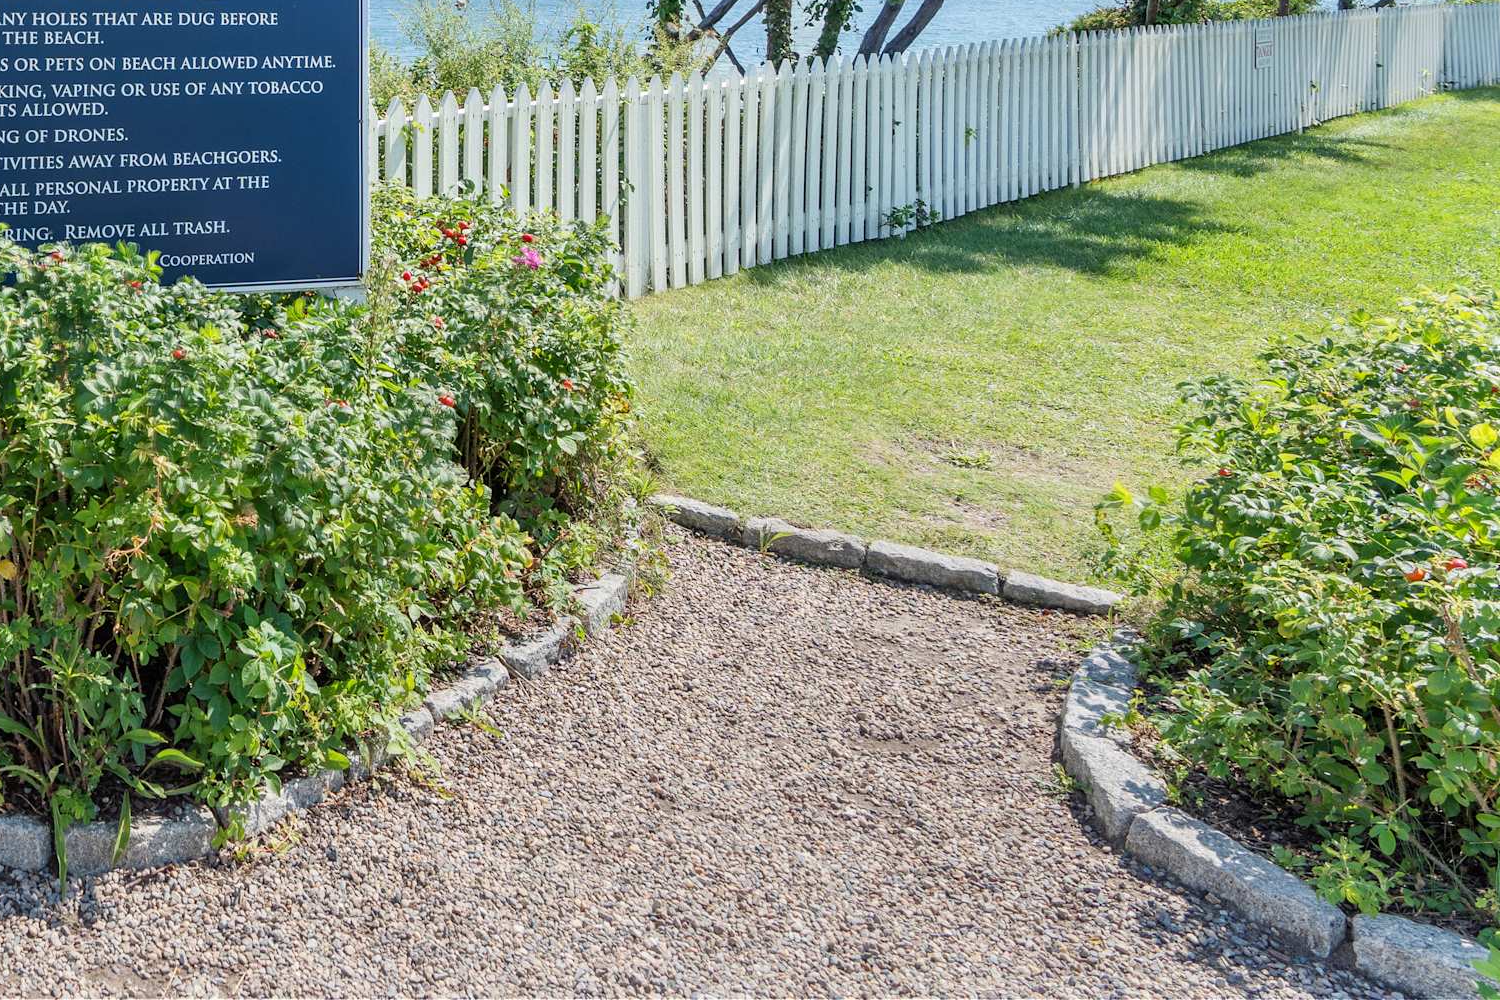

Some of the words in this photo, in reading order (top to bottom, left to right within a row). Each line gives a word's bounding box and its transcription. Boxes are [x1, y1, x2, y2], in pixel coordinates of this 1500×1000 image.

[31, 11, 88, 26] HOLES
[91, 12, 138, 26] THAT
[140, 12, 173, 26] ARE
[177, 12, 215, 26] DUG
[219, 12, 279, 26] BEFORE
[1, 31, 39, 45] THE
[43, 30, 105, 45] BEACH.
[13, 57, 41, 72] OR
[45, 57, 84, 72] PETS
[89, 57, 116, 71] ON
[122, 56, 176, 71] BEACH
[179, 55, 258, 70] ALLOWED
[260, 55, 336, 70] ANYTIME.
[50, 83, 116, 98] VAPING
[120, 82, 148, 97] OR
[150, 82, 181, 97] USE
[184, 82, 207, 96] OF
[210, 81, 245, 96] ANY
[247, 80, 324, 95] TOBACCO
[20, 102, 109, 117] ALLOWED.
[24, 129, 49, 144] OF
[54, 127, 129, 143] DRONES.
[67, 154, 116, 169] AWAY
[119, 152, 168, 168] FROM
[172, 149, 282, 166] BEACHGOERS.
[35, 179, 123, 196] PERSONAL
[127, 177, 211, 193] PROPERTY
[212, 176, 234, 191] AT
[236, 175, 270, 190] THE
[34, 200, 71, 215] DAY.
[64, 224, 136, 240] REMOVE
[139, 223, 168, 236] ALL
[173, 221, 230, 235] TRASH.
[159, 252, 255, 268] COOPERATION
